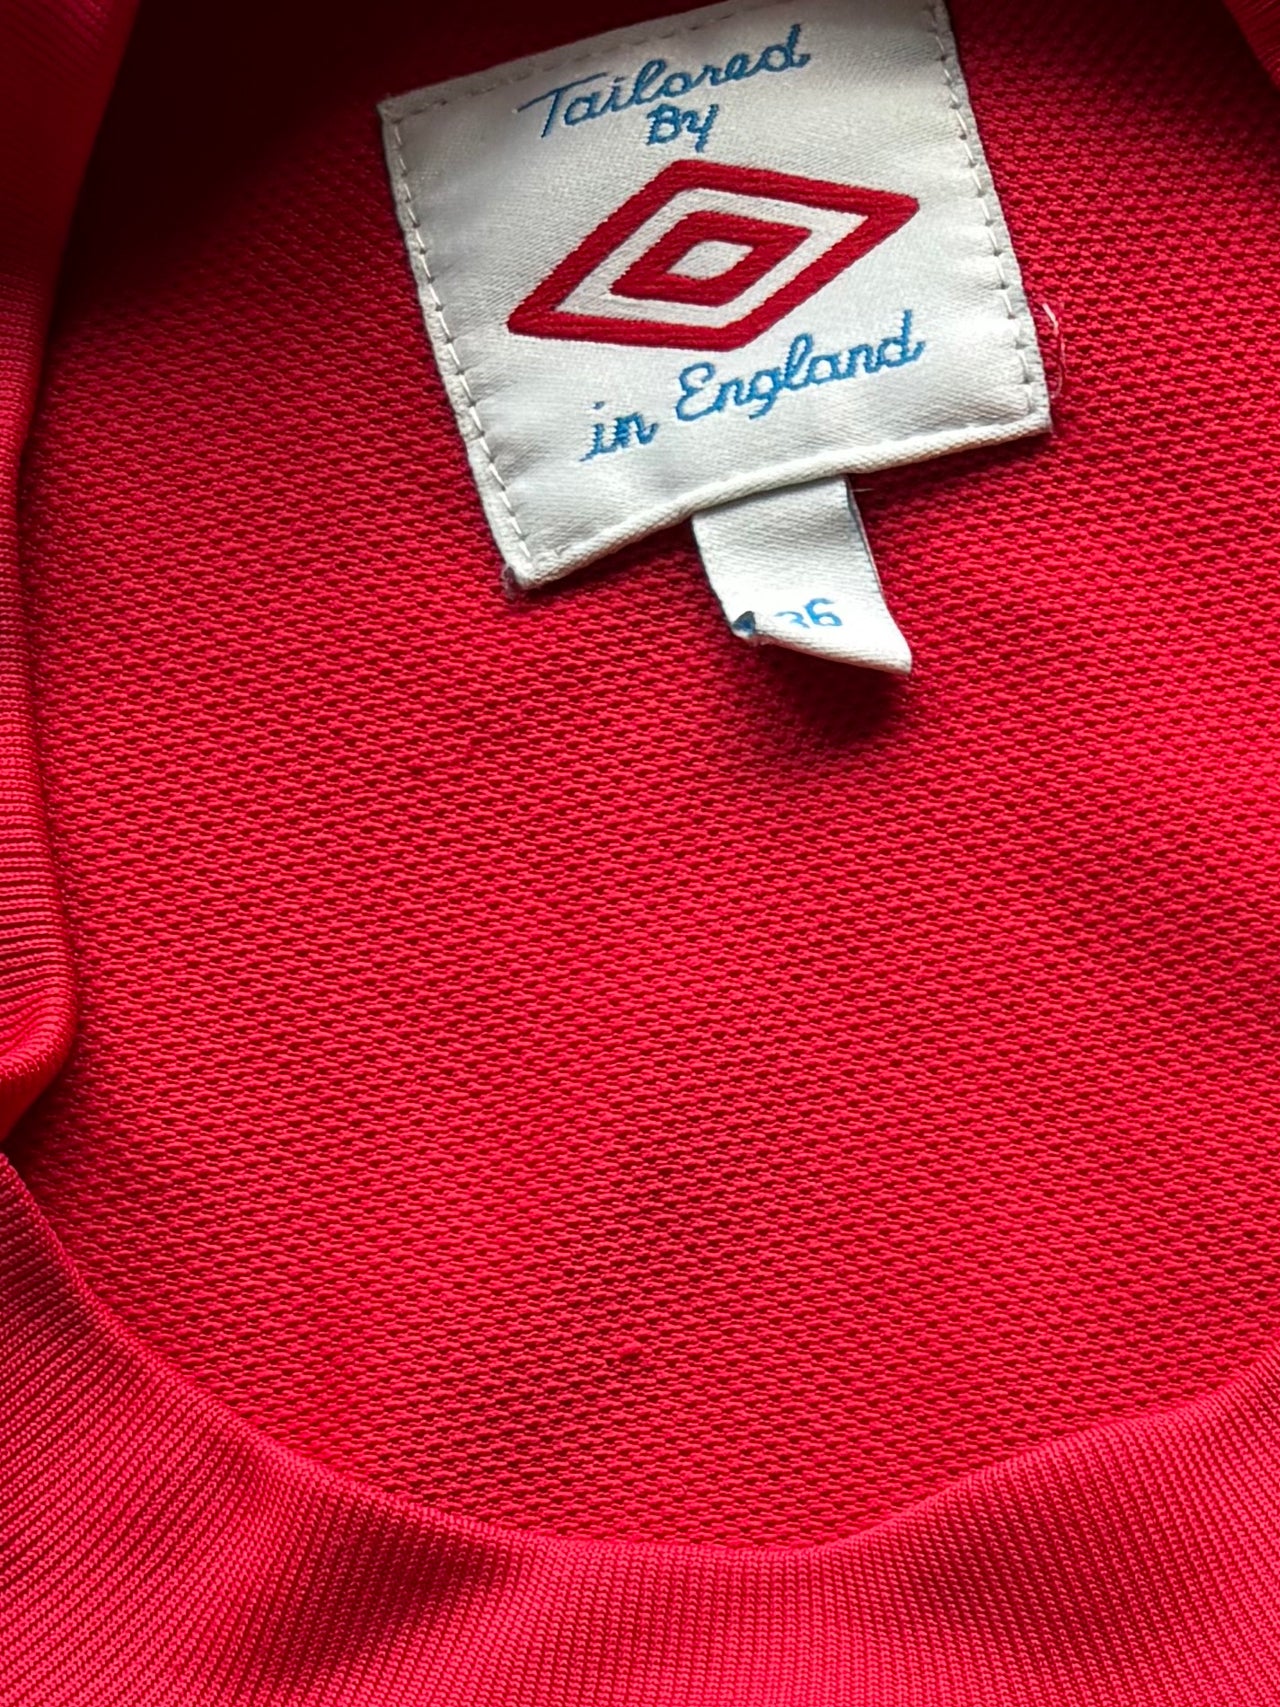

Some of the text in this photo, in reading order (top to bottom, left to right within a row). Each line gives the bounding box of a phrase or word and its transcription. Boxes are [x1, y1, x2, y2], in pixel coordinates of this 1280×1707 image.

[515, 23, 811, 138] Tailored
[647, 103, 720, 153] By
[579, 308, 925, 462] in England
